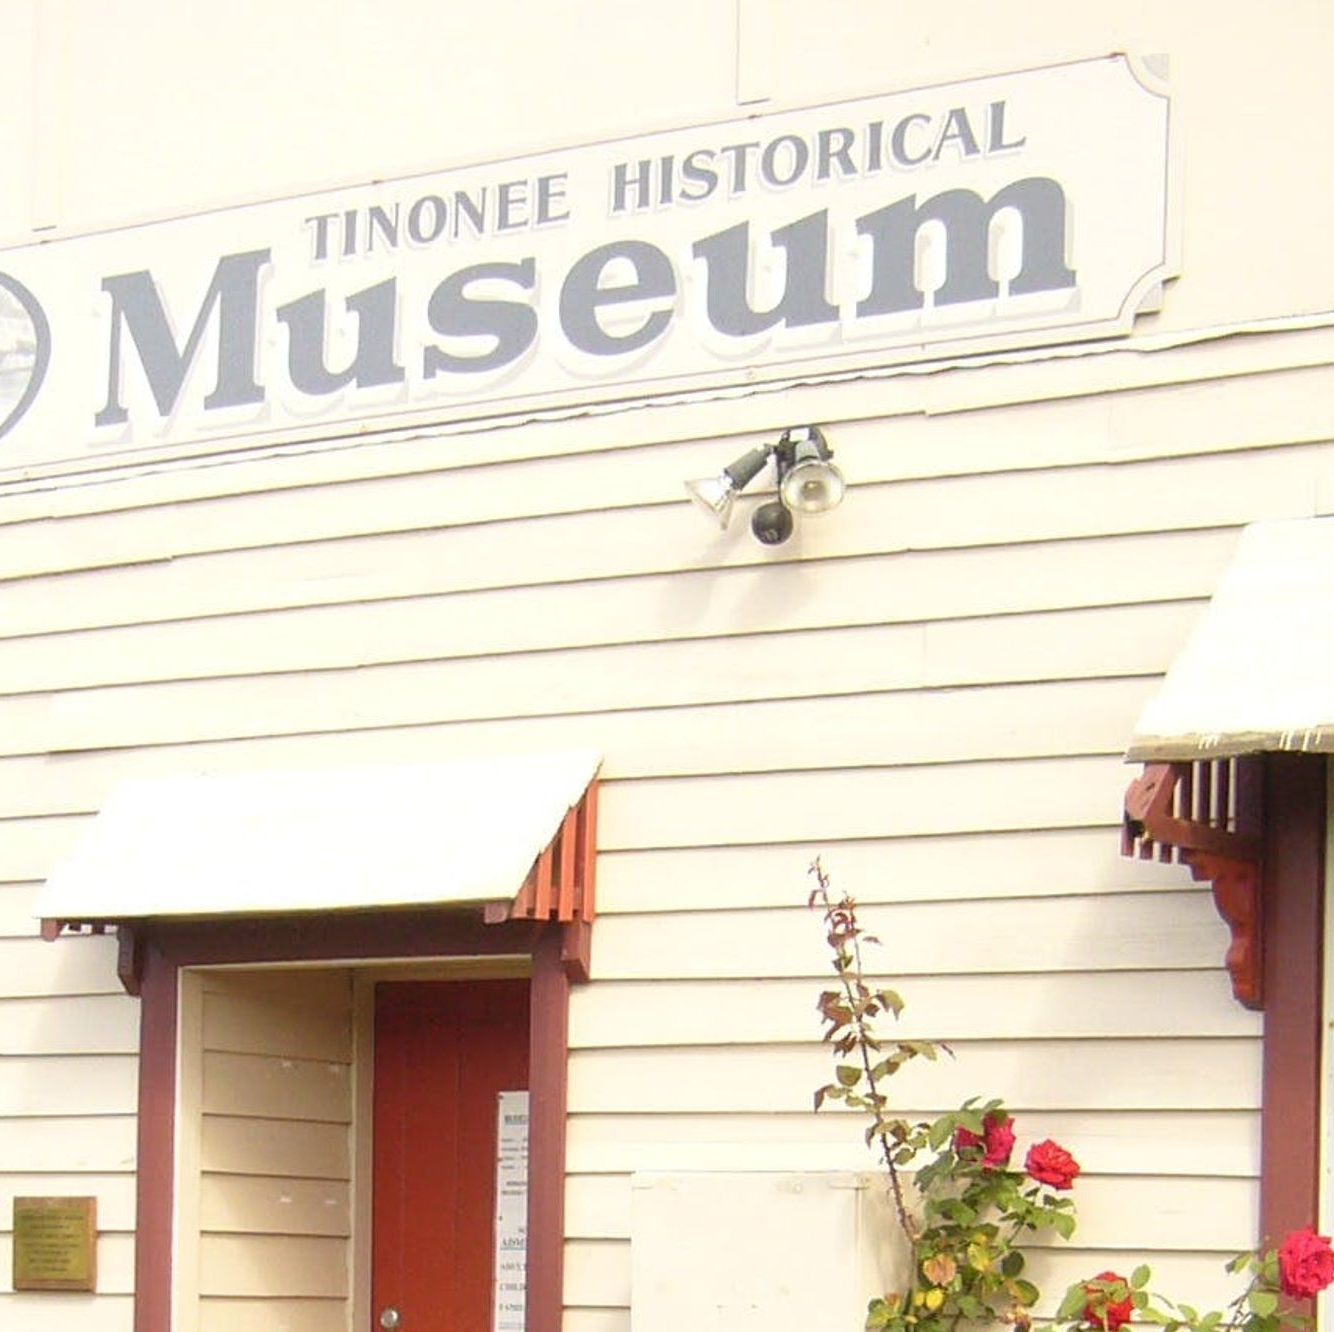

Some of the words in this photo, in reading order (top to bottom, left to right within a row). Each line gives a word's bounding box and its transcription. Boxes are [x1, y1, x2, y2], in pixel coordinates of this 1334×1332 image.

[304, 172, 571, 261] TINONEE
[612, 100, 1027, 212] HISTORICAL
[93, 175, 1078, 428] Museum
